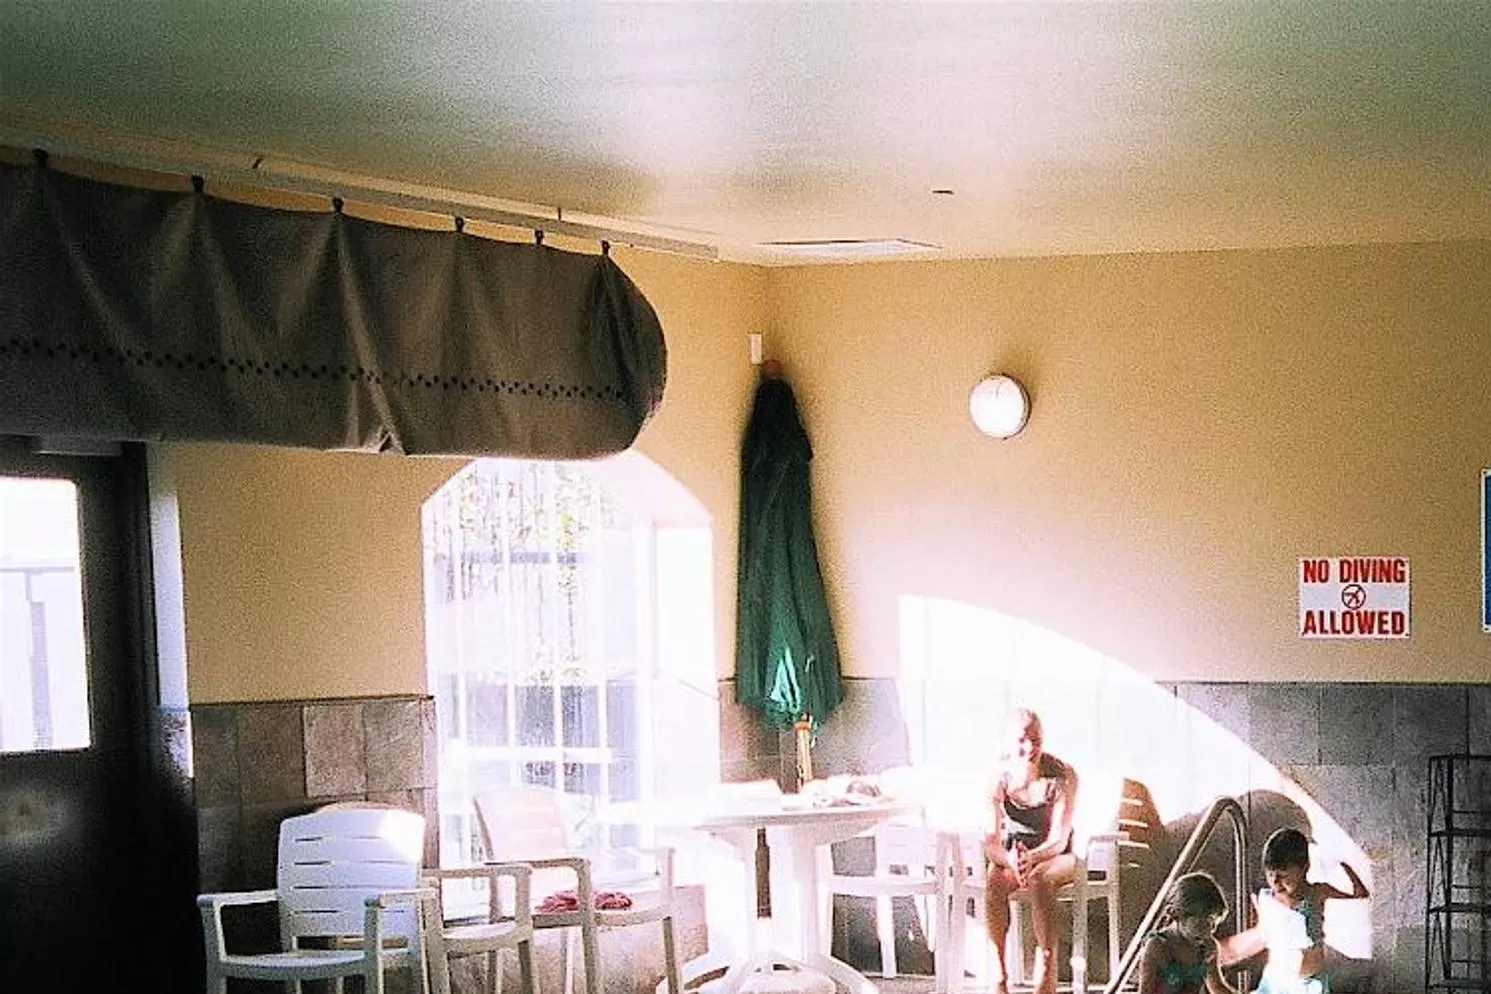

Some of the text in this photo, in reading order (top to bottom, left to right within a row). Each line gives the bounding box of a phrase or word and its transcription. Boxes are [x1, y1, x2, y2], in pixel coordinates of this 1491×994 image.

[1303, 559, 1406, 583] NO DIVING
[1304, 610, 1405, 635] ALLOWED
